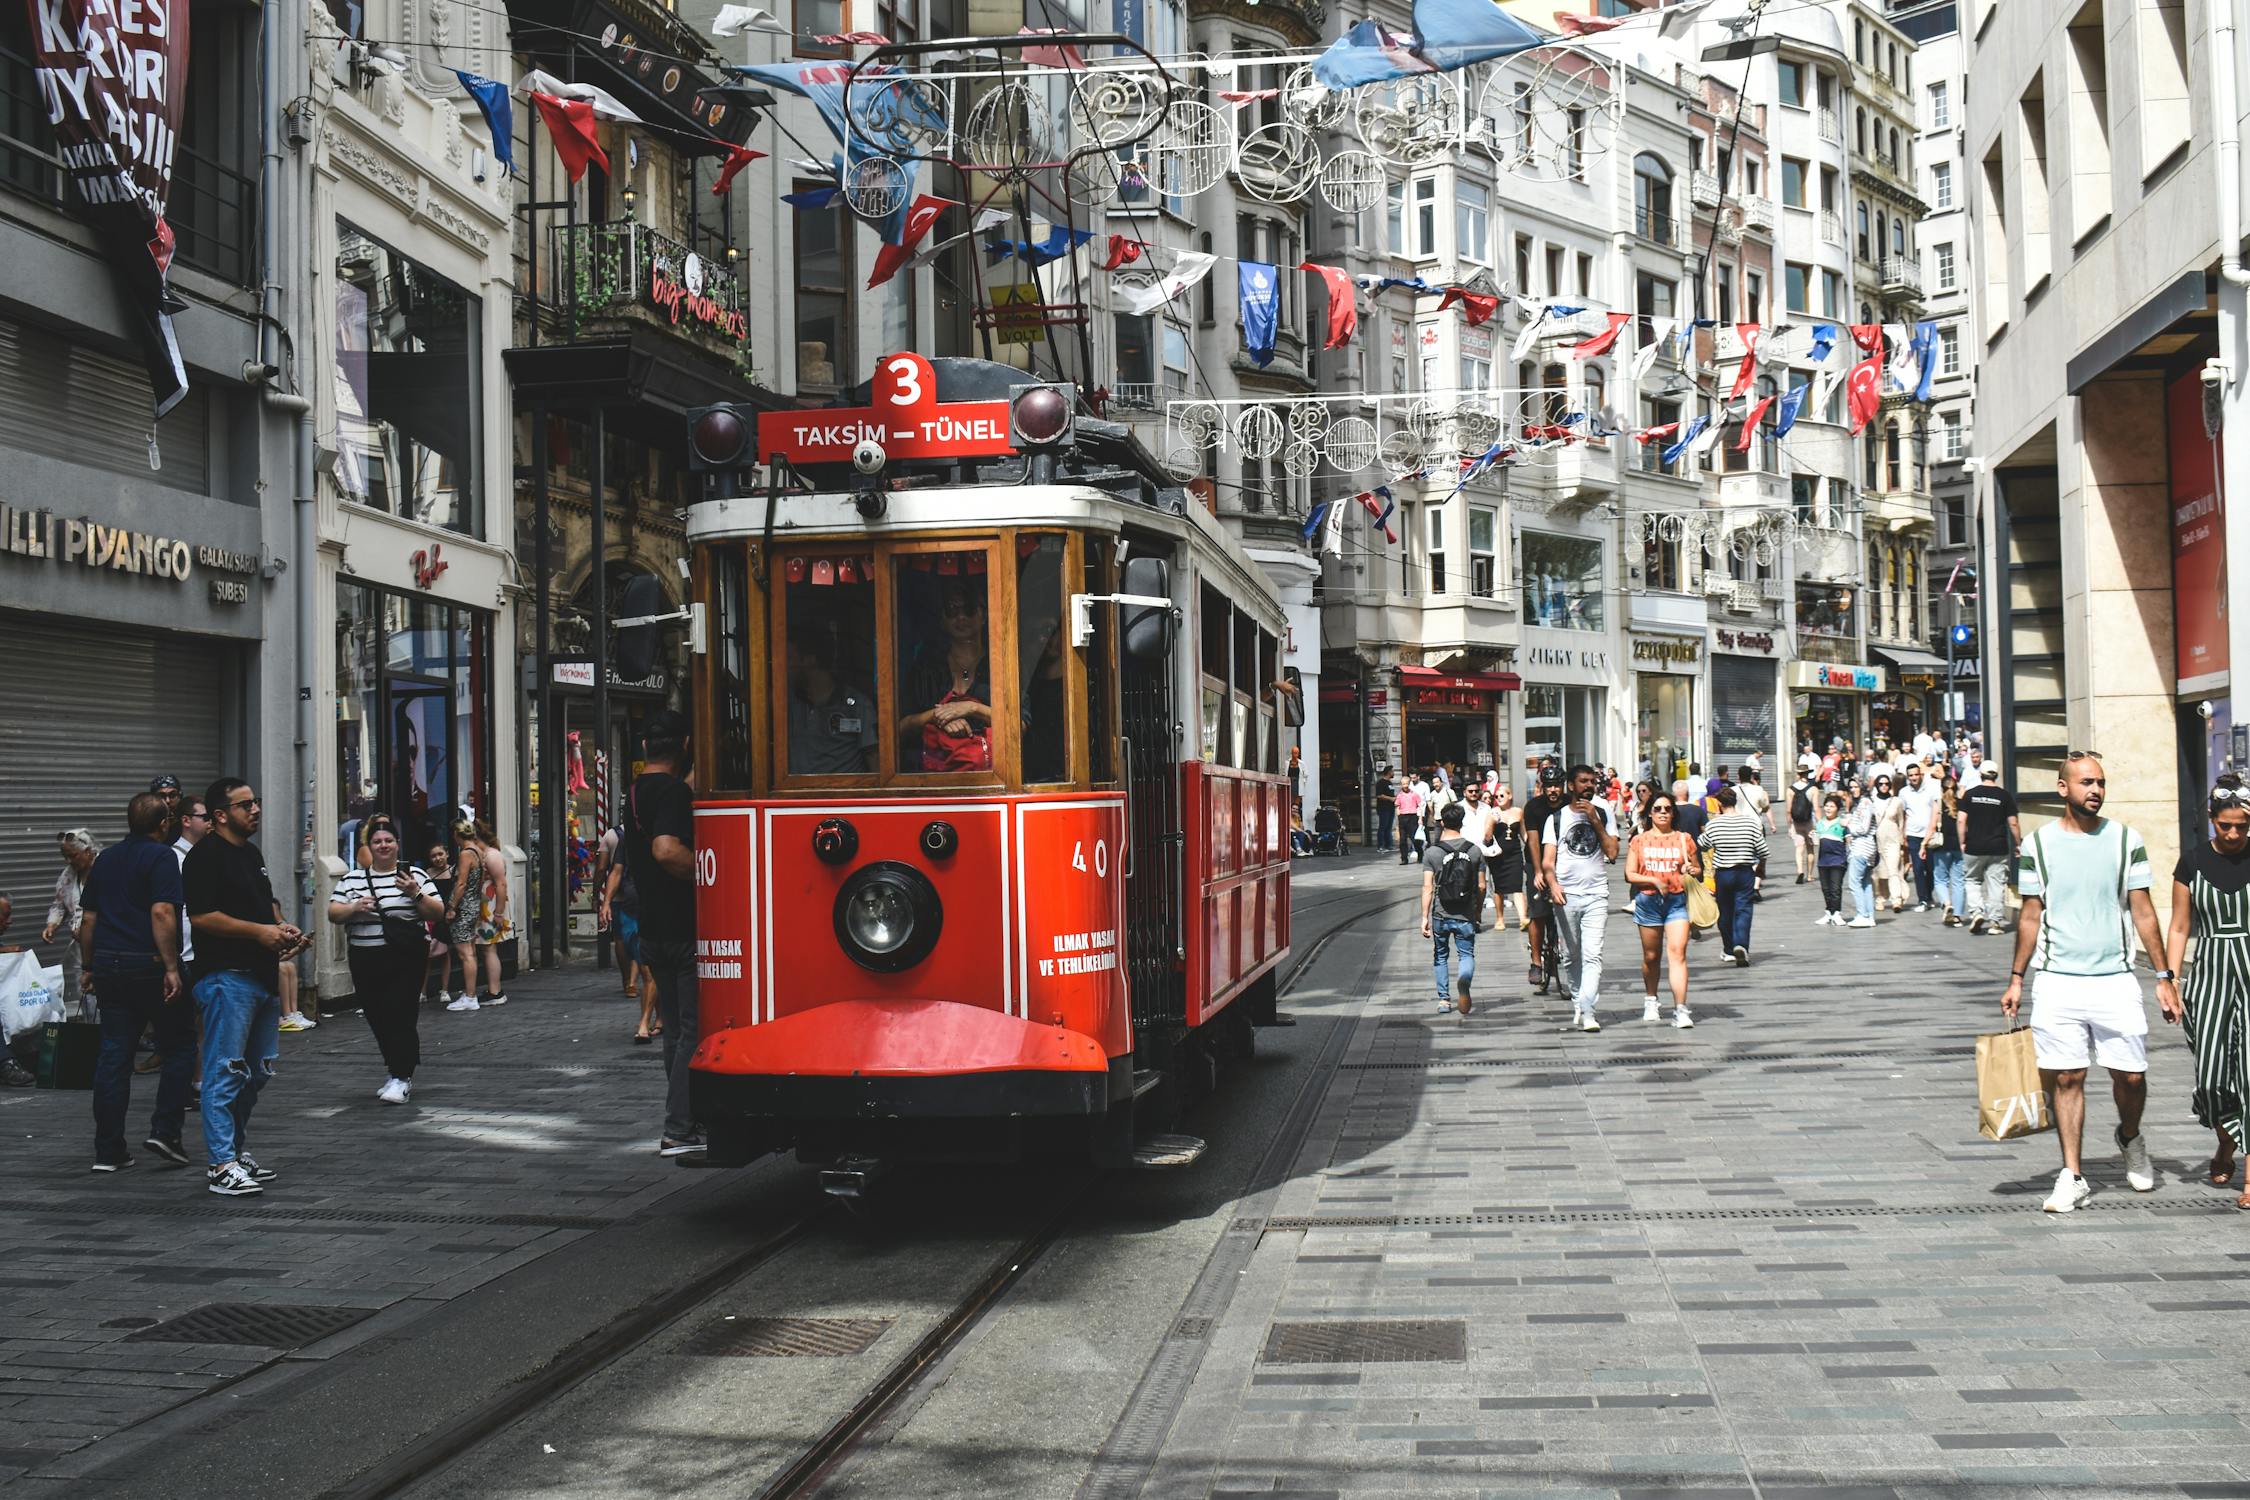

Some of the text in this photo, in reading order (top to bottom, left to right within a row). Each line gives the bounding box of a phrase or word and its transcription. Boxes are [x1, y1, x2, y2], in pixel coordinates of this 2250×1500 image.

[1004, 329, 1036, 341] VOLT
[887, 357, 922, 406] 3
[793, 419, 886, 447] TAKSİM
[920, 416, 1005, 442] TÜNEL
[63, 516, 192, 582] PİYANGO
[1528, 647, 1608, 668] JIMMY KEY
[1645, 861, 1679, 872] GOALS
[710, 939, 742, 956] YASAK
[1053, 929, 1116, 952] ILMAK YASAK
[1039, 950, 1117, 977] VE TEHLİKELİDİR
